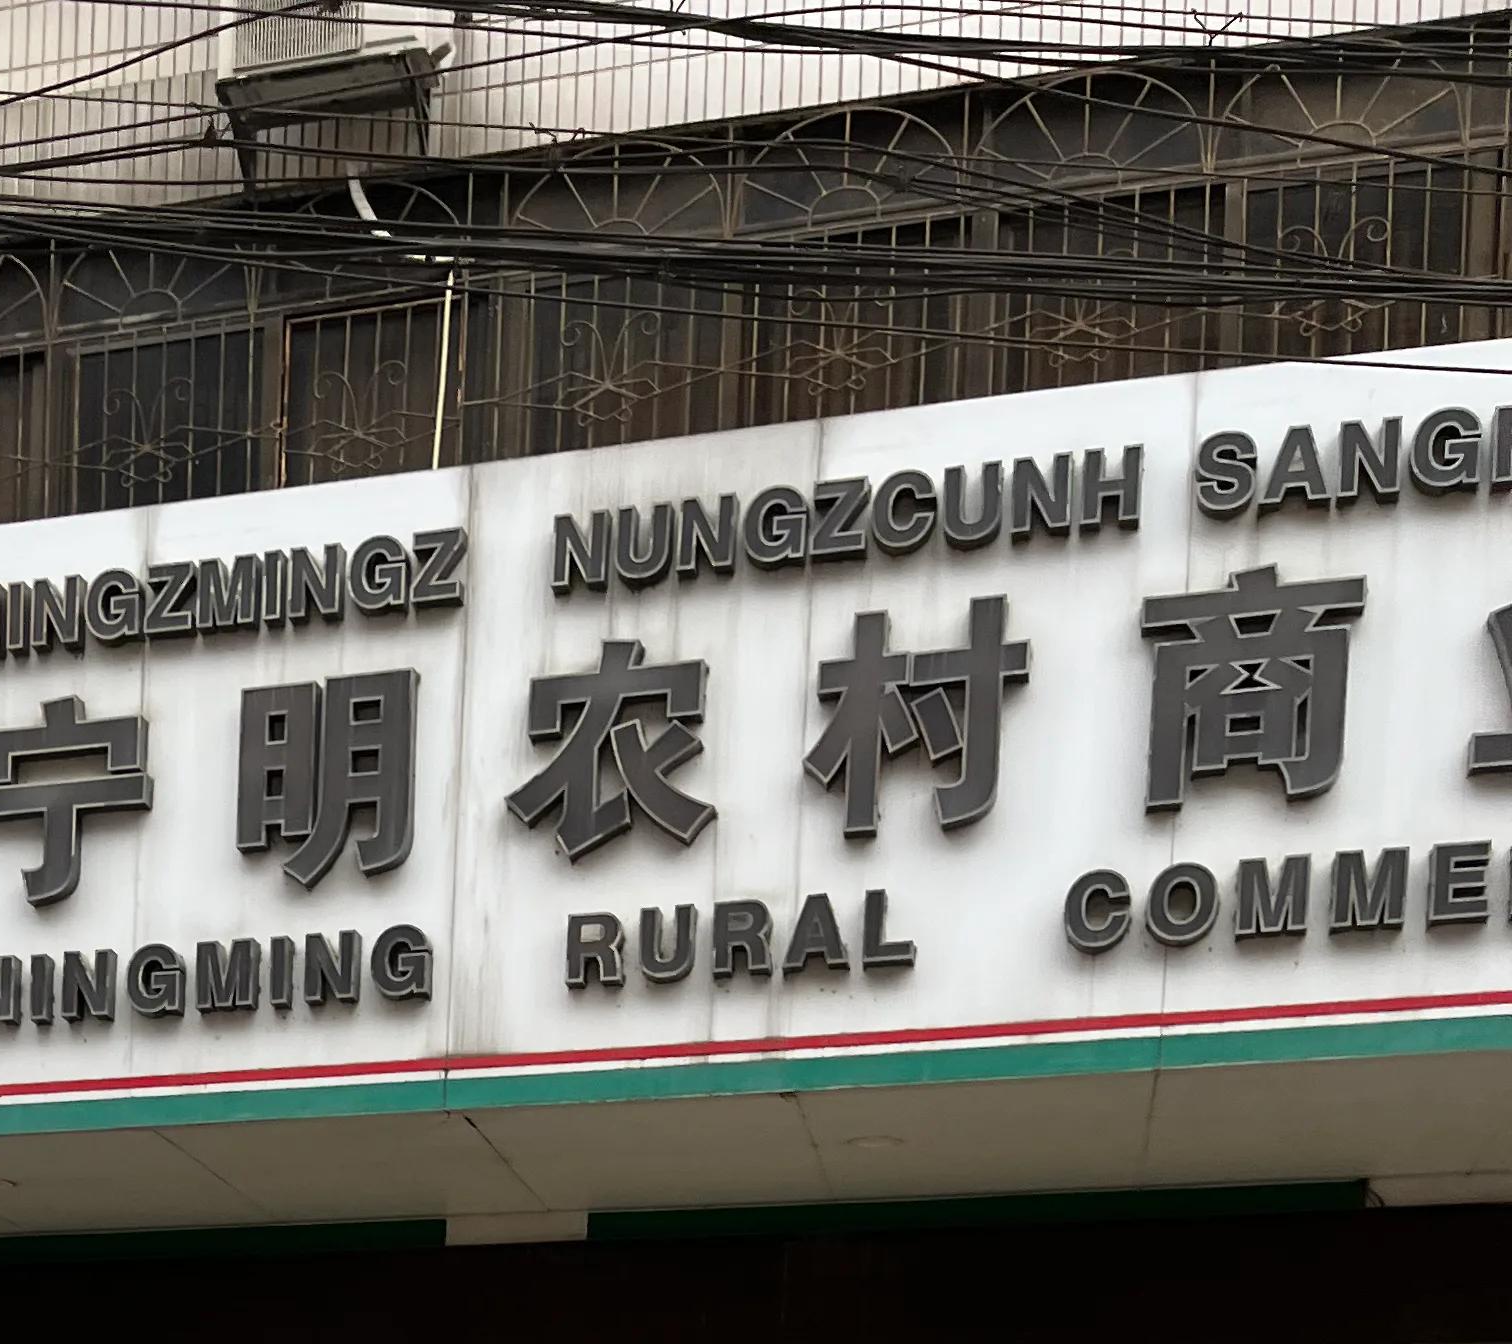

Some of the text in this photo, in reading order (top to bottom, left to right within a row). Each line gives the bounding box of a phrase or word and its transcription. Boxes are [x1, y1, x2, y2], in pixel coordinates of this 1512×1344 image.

[552, 444, 1144, 596] NUNGZCUNH
[565, 889, 917, 990] RURAL
[1064, 840, 1512, 955] COMME
